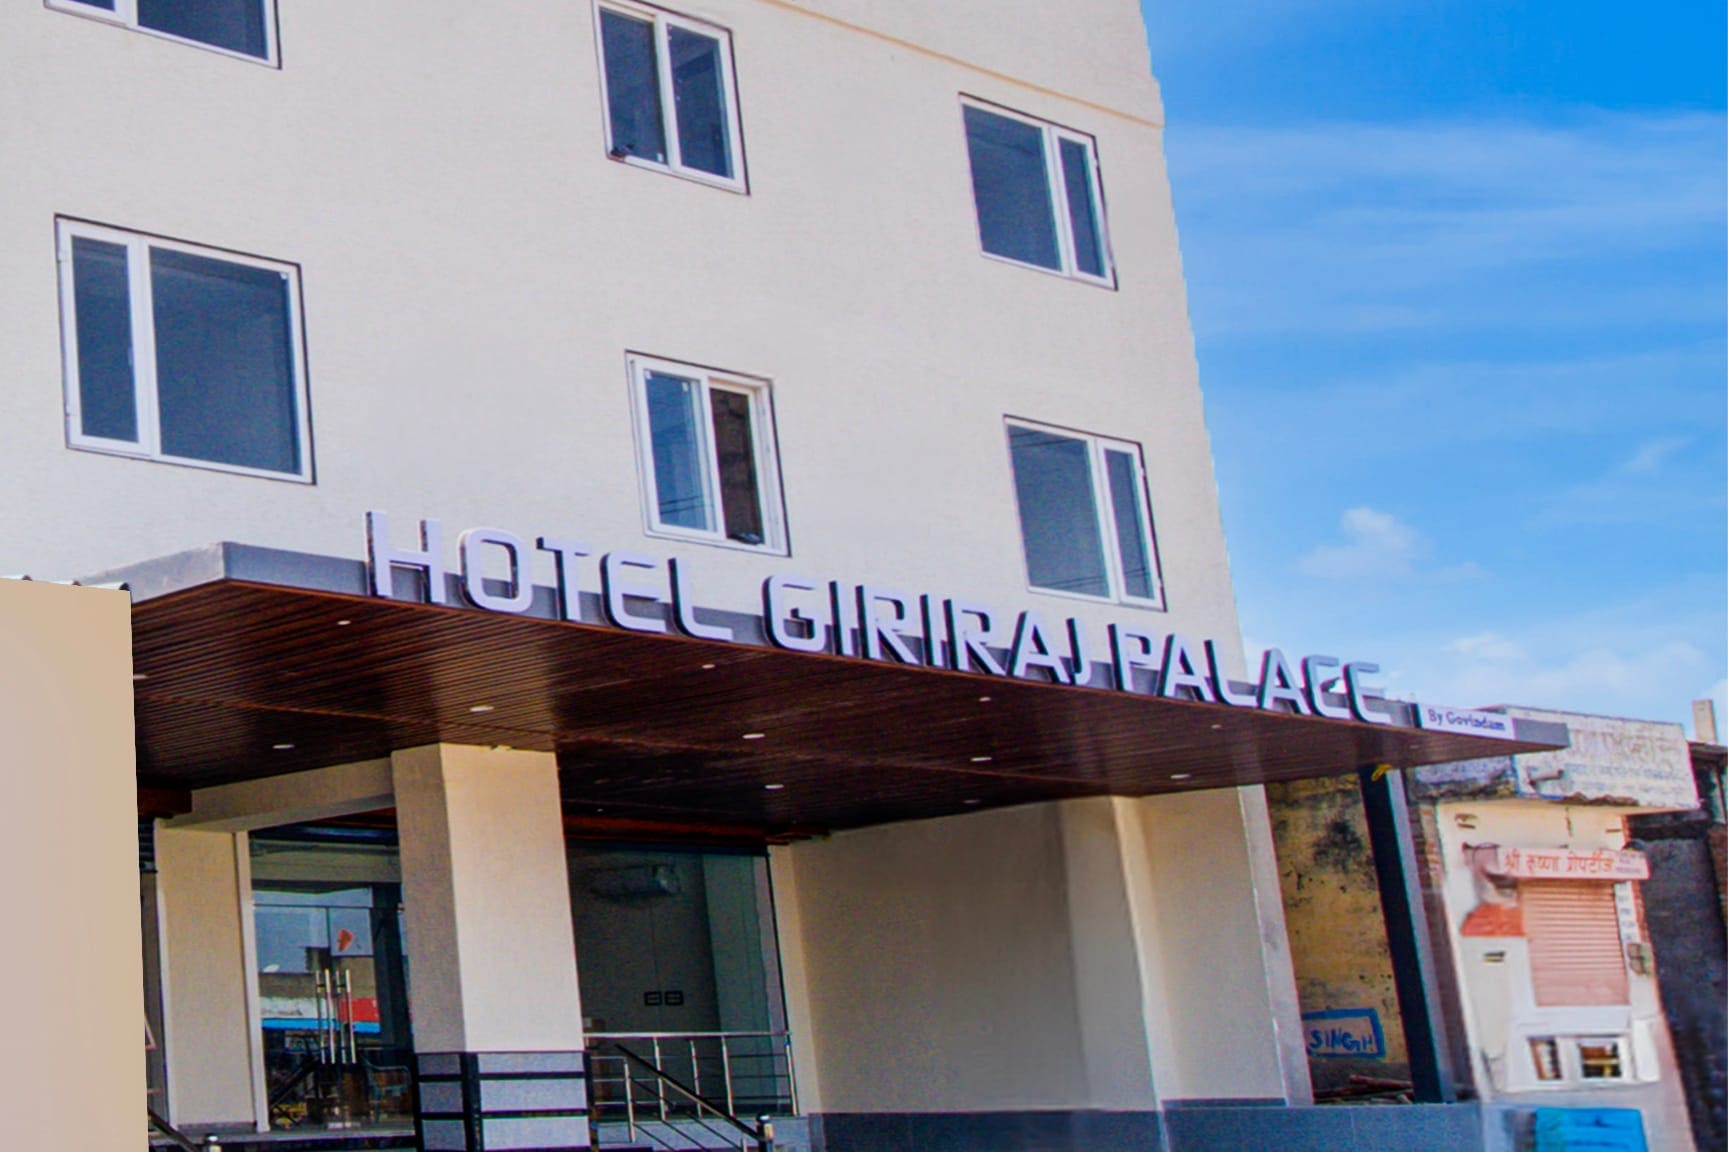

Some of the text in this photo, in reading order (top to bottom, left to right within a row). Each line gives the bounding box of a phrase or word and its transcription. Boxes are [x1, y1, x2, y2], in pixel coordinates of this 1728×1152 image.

[365, 511, 1392, 726] HOTEL GIRIRAJ PALACE
[1427, 708, 1443, 727] By
[1309, 1027, 1373, 1053] SINGH
